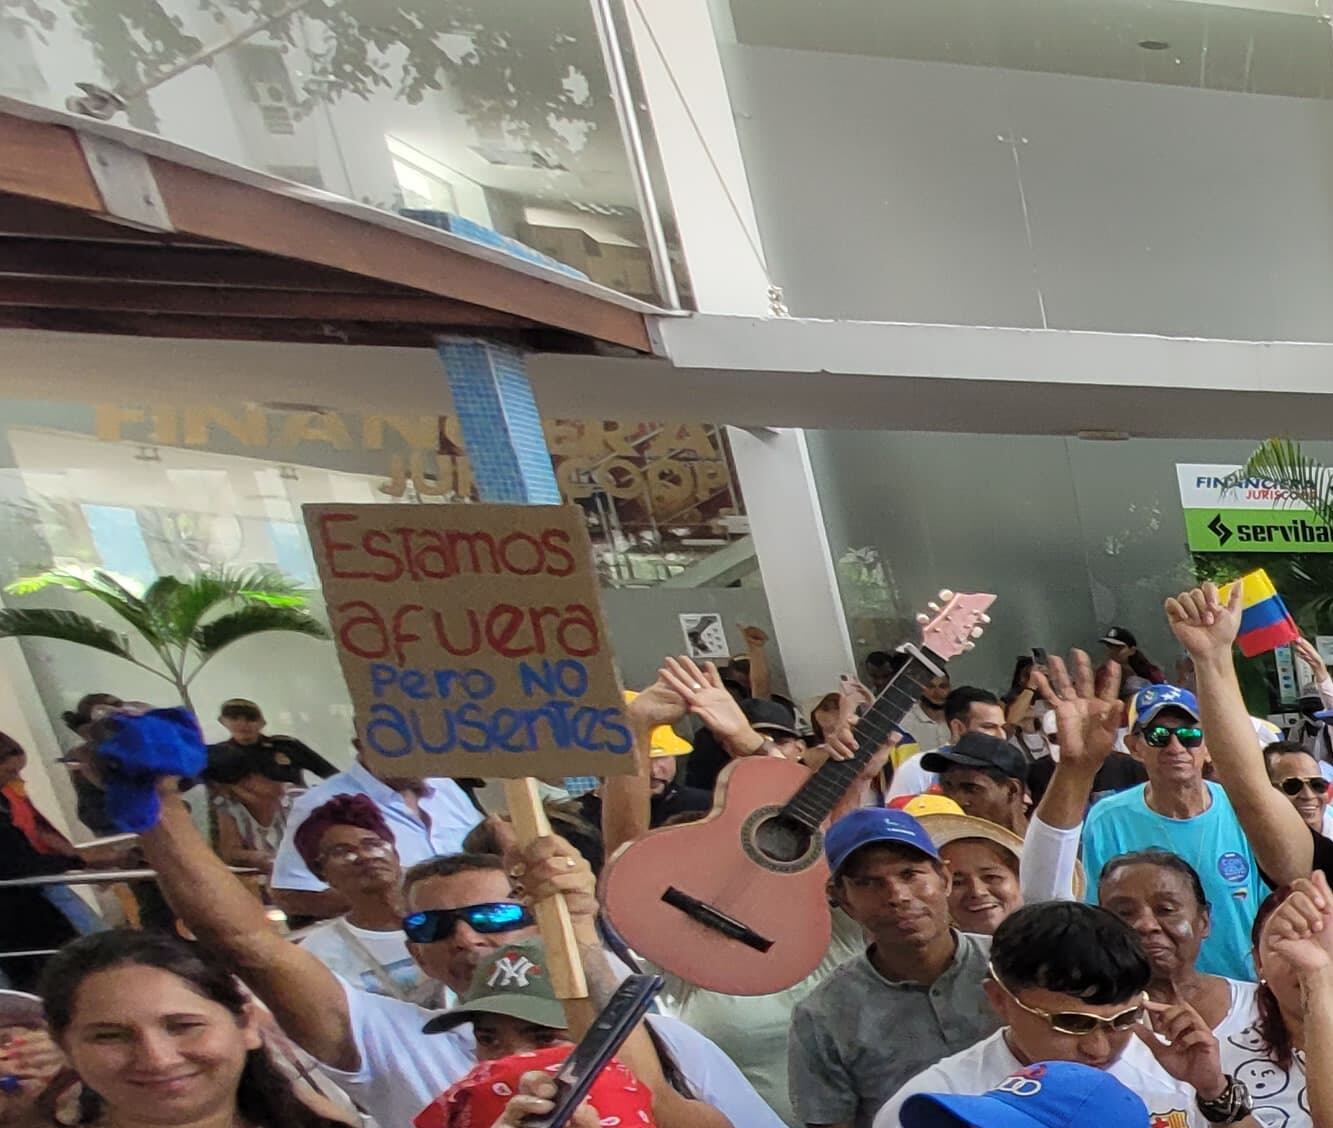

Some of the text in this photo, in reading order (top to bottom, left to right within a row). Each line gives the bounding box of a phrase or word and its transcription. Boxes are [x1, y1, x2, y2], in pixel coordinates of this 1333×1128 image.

[336, 600, 600, 667] afuera
[370, 658, 588, 700] Pero NO
